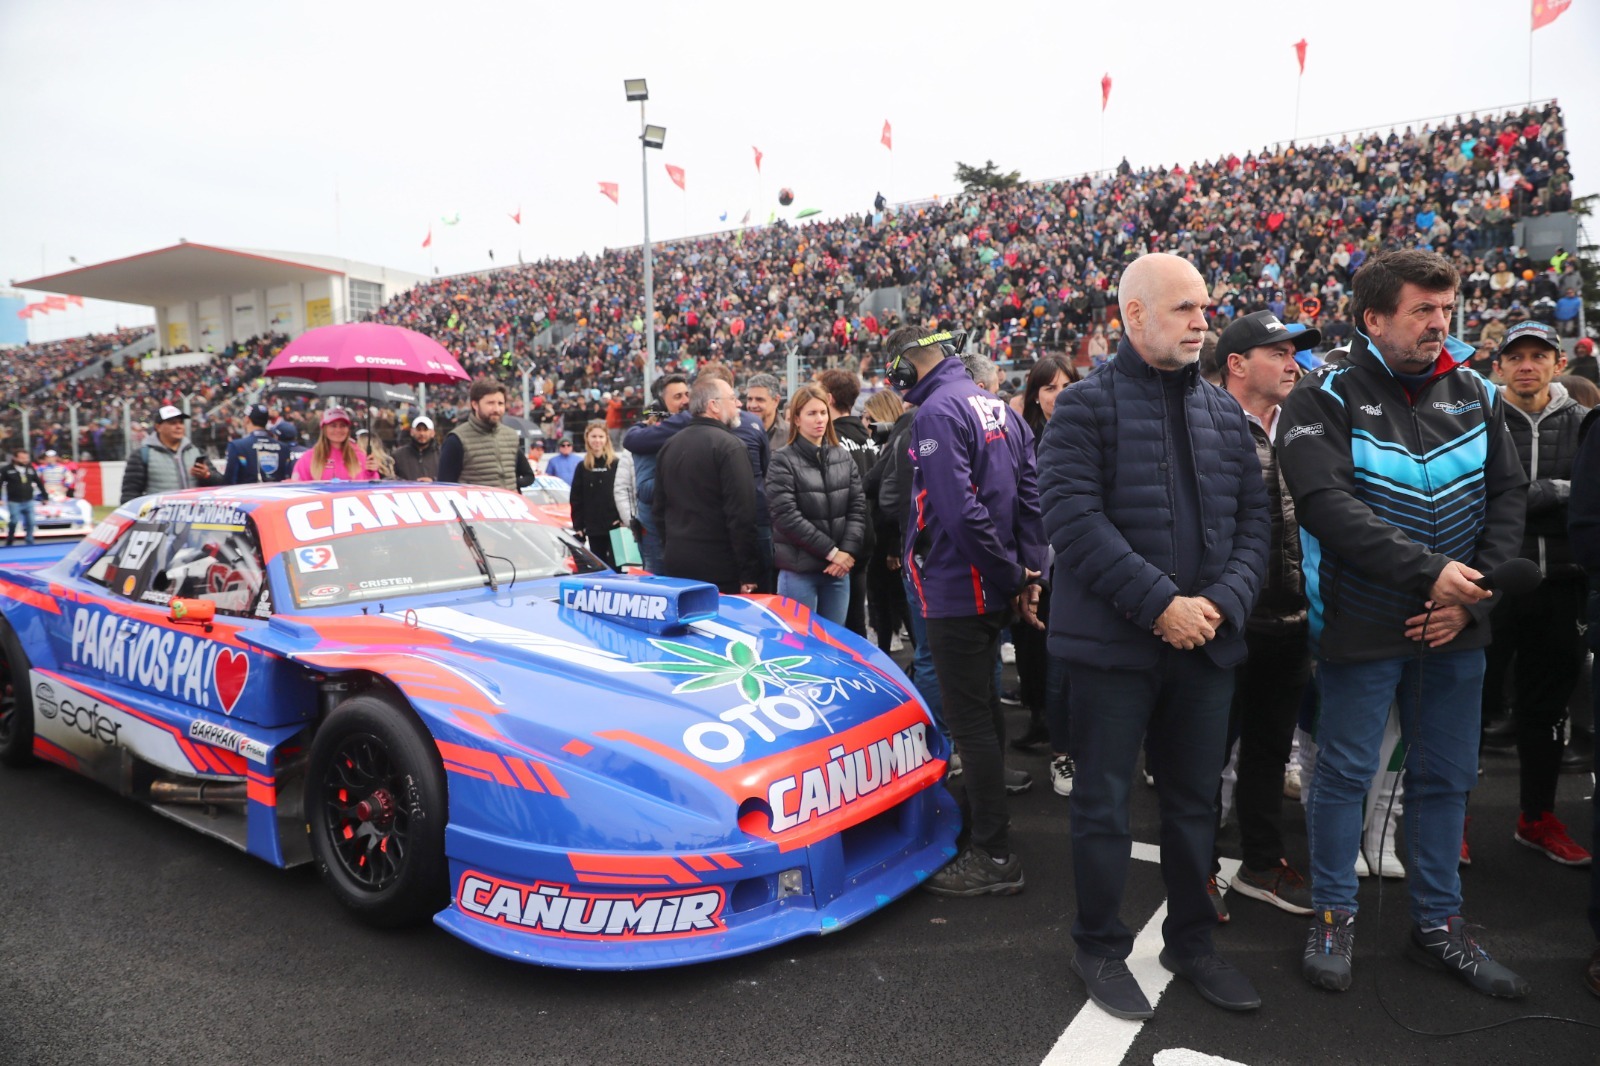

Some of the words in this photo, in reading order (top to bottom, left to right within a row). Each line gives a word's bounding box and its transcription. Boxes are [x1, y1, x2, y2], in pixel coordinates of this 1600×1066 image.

[917, 331, 953, 346] DAVICOM
[366, 356, 407, 366] OTOWIL
[286, 489, 540, 541] CAÑUMIR
[118, 530, 165, 570] 197
[359, 576, 414, 589] CRISTEM
[563, 584, 669, 621] CAÑUMIR
[71, 607, 130, 678] PARA
[126, 624, 176, 693] VOS
[60, 699, 123, 747] safer
[191, 720, 240, 749] BARPRAN
[682, 696, 816, 764] OTO
[767, 721, 934, 834] CAÑUMIR
[460, 876, 724, 935] CAÑUMIR
